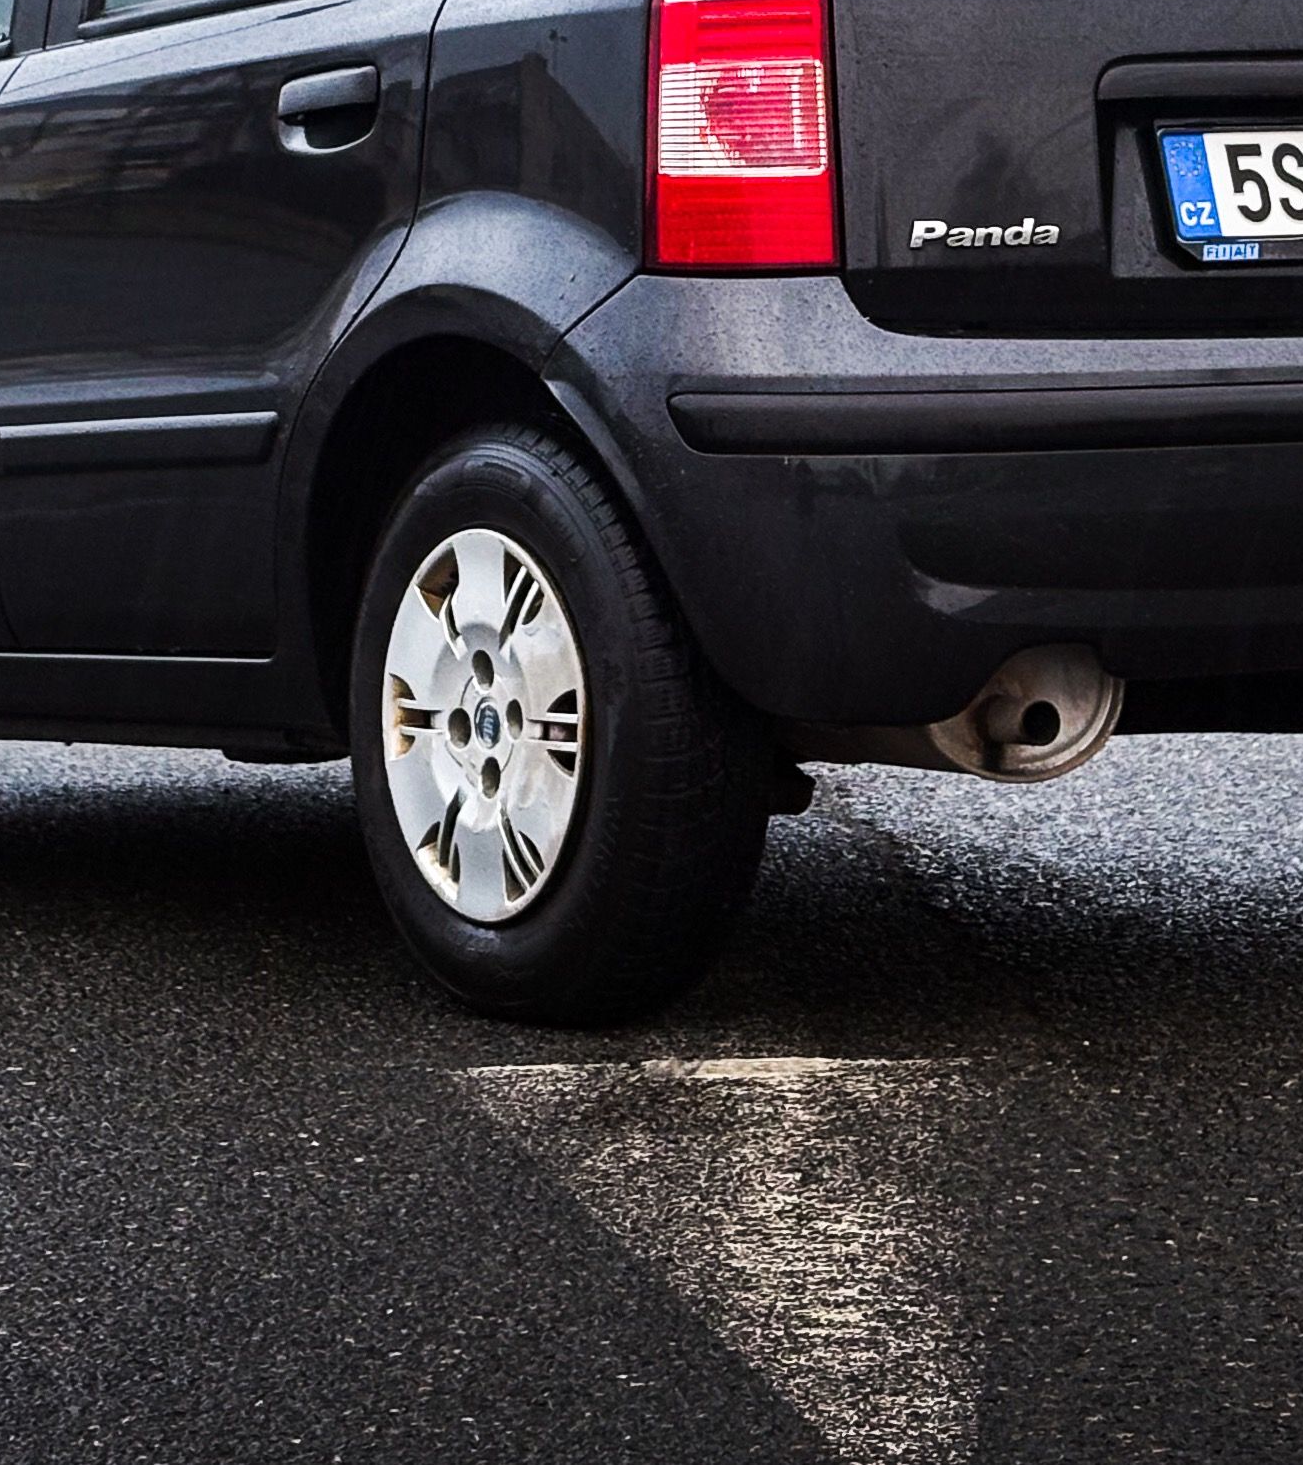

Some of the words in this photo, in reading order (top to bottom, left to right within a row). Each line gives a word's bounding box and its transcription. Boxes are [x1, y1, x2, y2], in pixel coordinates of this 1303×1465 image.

[1179, 202, 1216, 227] CZ
[909, 218, 1061, 249] Panda
[1204, 244, 1259, 259] FIAT
